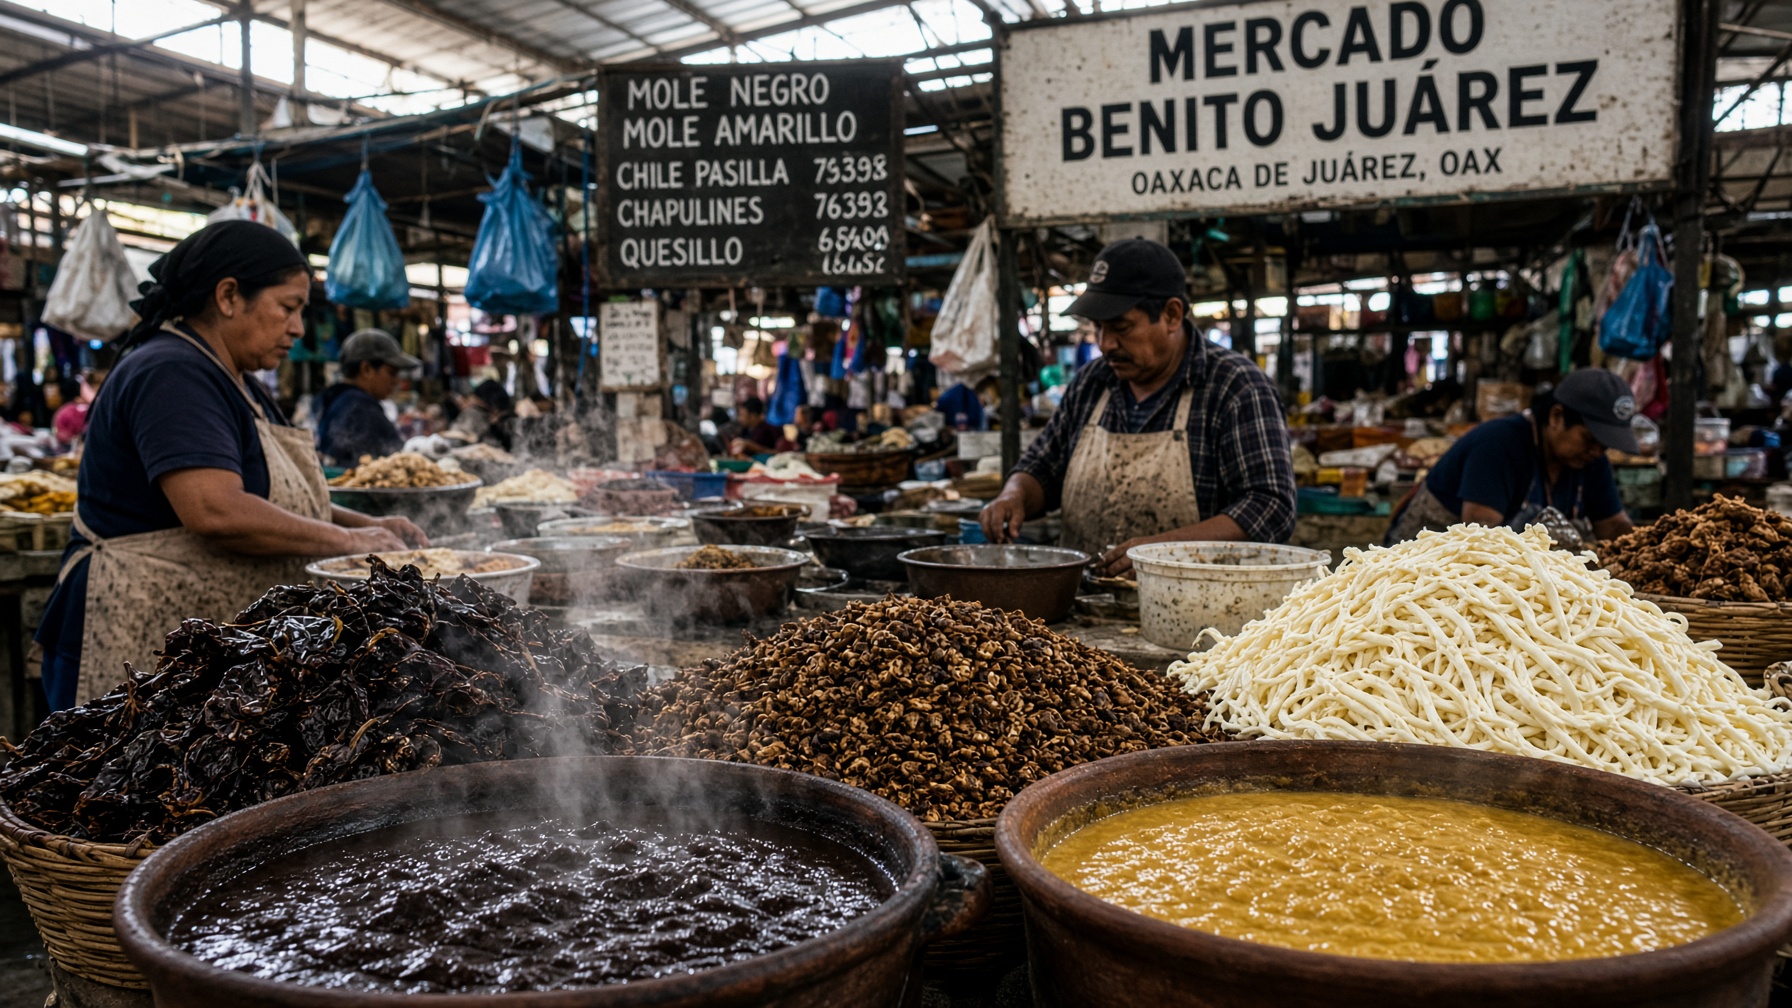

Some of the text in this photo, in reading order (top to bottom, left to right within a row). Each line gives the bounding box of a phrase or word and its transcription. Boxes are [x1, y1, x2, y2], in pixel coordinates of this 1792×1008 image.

[1149, 0, 1485, 84] MERCADO
[628, 73, 830, 110] MOLE NEGRO
[1061, 58, 1599, 162] BENITO JUÁREZ
[623, 111, 857, 149] MOLE AMARILLO
[616, 161, 683, 190] CHILE
[695, 158, 790, 188] PASILLA
[1132, 148, 1502, 195] OAXACA DE JUÁREZ, OAX
[617, 196, 764, 228] CHAPULINES
[620, 237, 743, 269] QUESILLO
